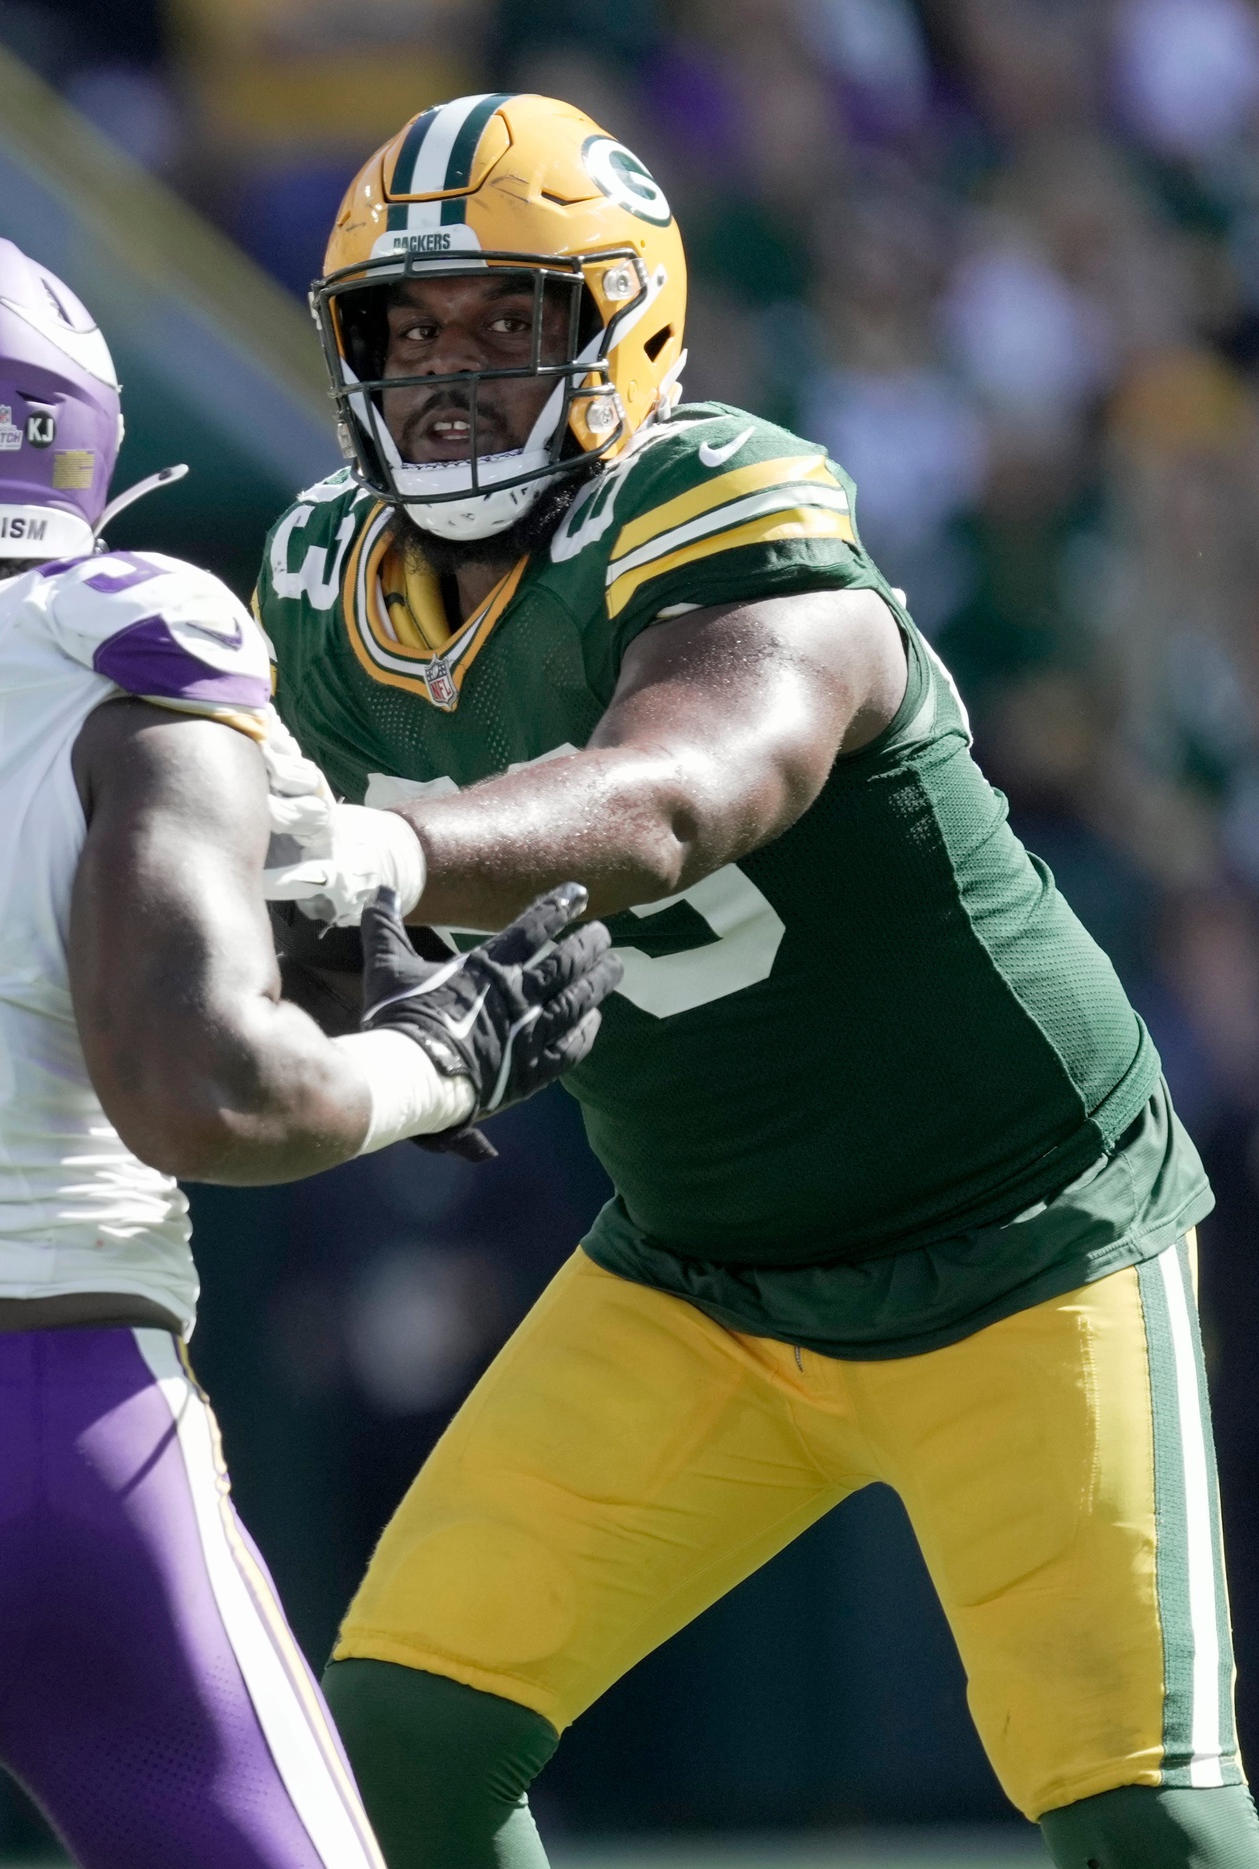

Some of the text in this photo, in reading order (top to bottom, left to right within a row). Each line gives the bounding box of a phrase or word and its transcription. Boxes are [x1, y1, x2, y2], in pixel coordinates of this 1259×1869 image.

[587, 138, 671, 220] G
[393, 232, 451, 252] PACKERS
[27, 417, 54, 442] KJ
[429, 678, 453, 701] NFL
